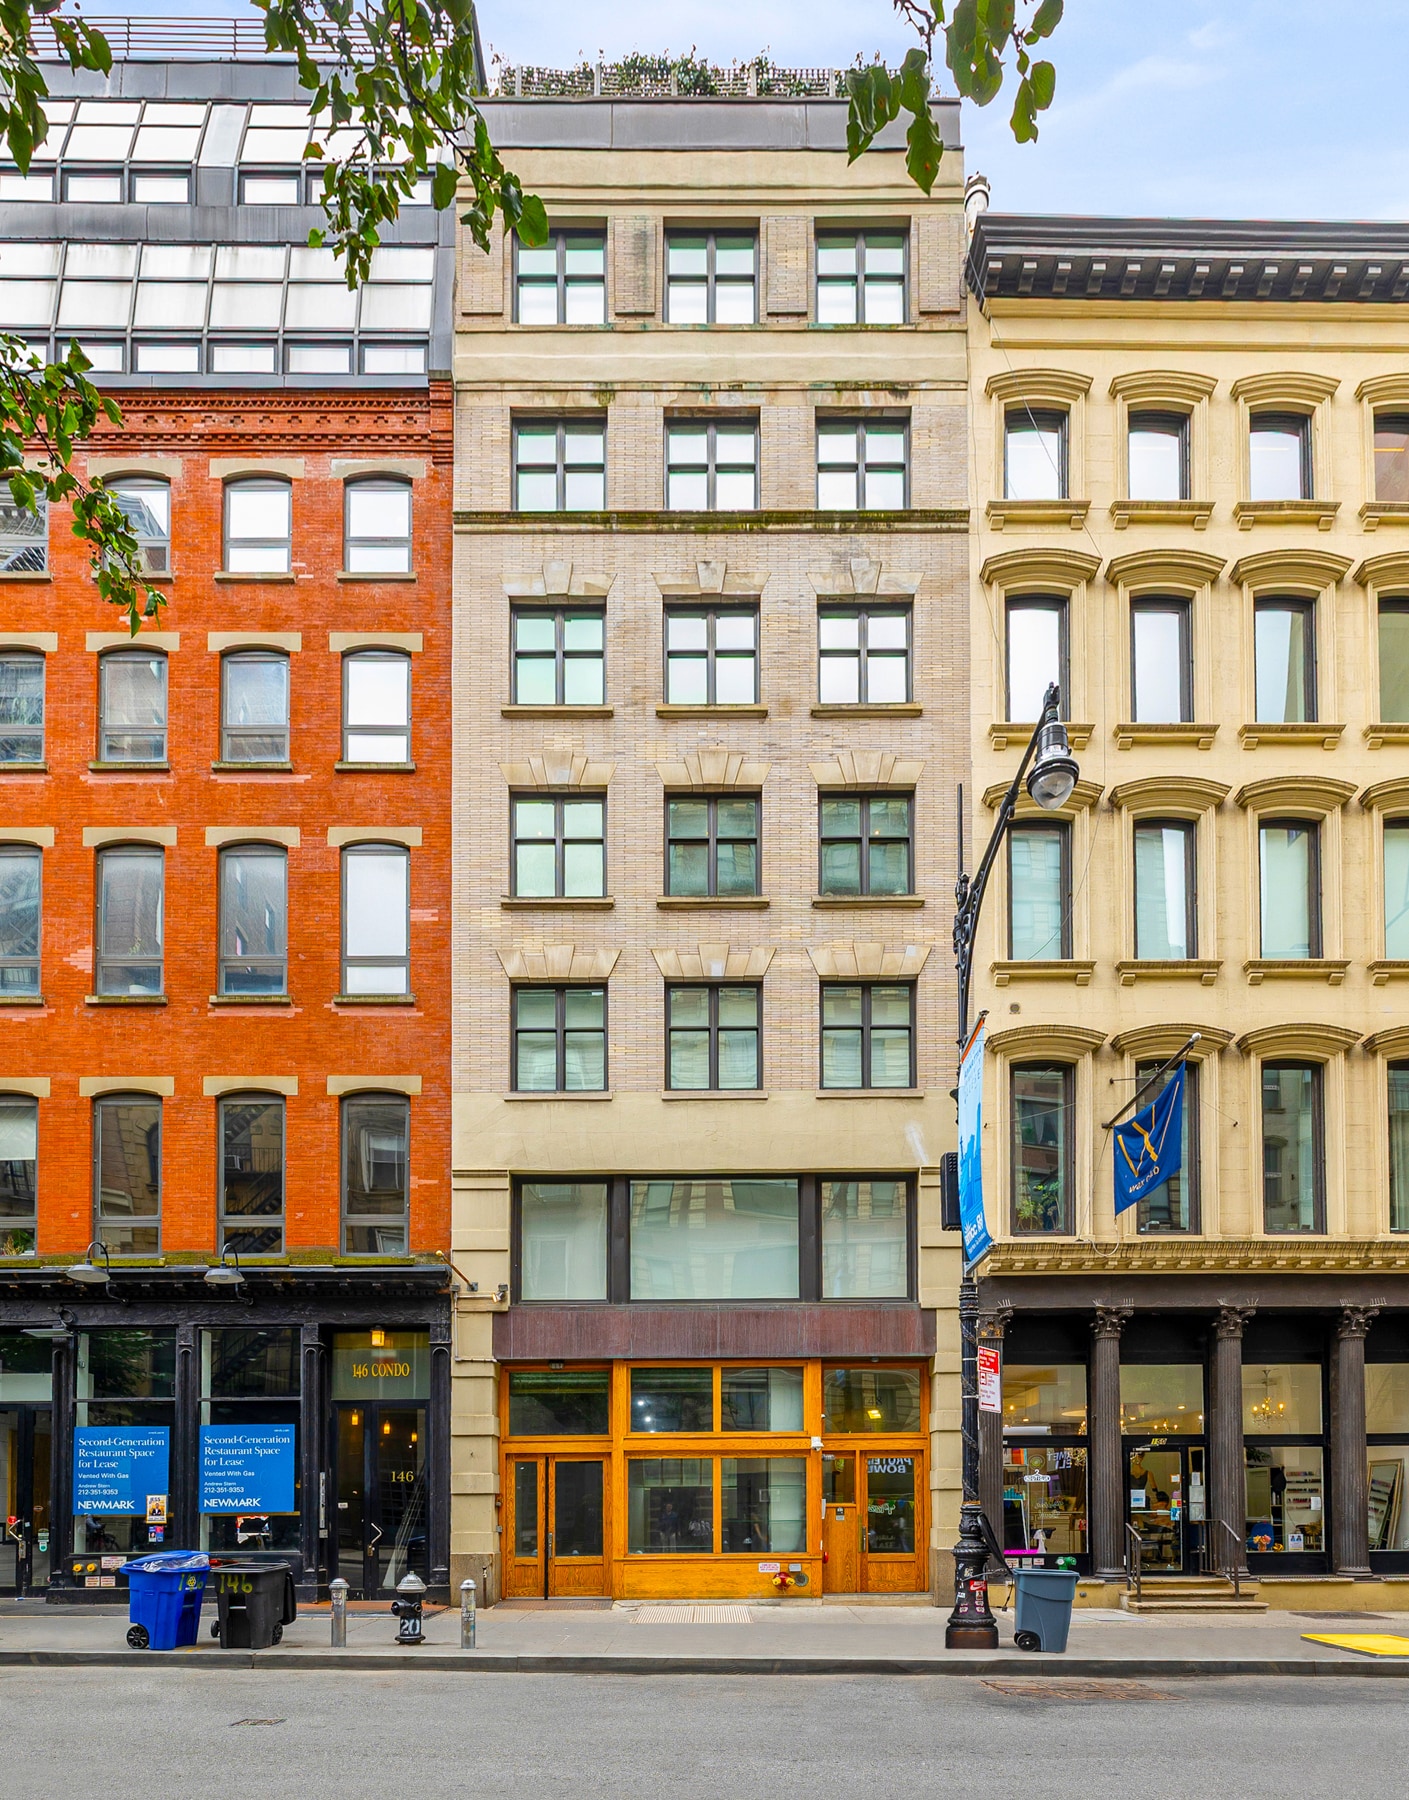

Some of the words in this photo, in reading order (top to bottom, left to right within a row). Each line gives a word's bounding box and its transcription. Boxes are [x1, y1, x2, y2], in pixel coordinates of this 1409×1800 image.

[352, 1363, 368, 1378] 146
[371, 1362, 410, 1377] CONDO
[78, 1437, 165, 1446] Second-Generation
[204, 1435, 290, 1444] Second-Generation
[78, 1448, 127, 1457] Restaurant
[128, 1448, 155, 1460] Space
[204, 1446, 252, 1455] Restaurant
[254, 1446, 280, 1458] Space
[78, 1460, 92, 1468] for
[94, 1460, 119, 1468] Lease
[204, 1457, 218, 1466] for
[220, 1457, 244, 1466] Lease
[391, 1471, 414, 1482] 146
[78, 1500, 135, 1510] NEWMARK
[204, 1498, 262, 1508] NEWMARK
[220, 1574, 253, 1594] 146
[400, 1618, 420, 1635] 20
